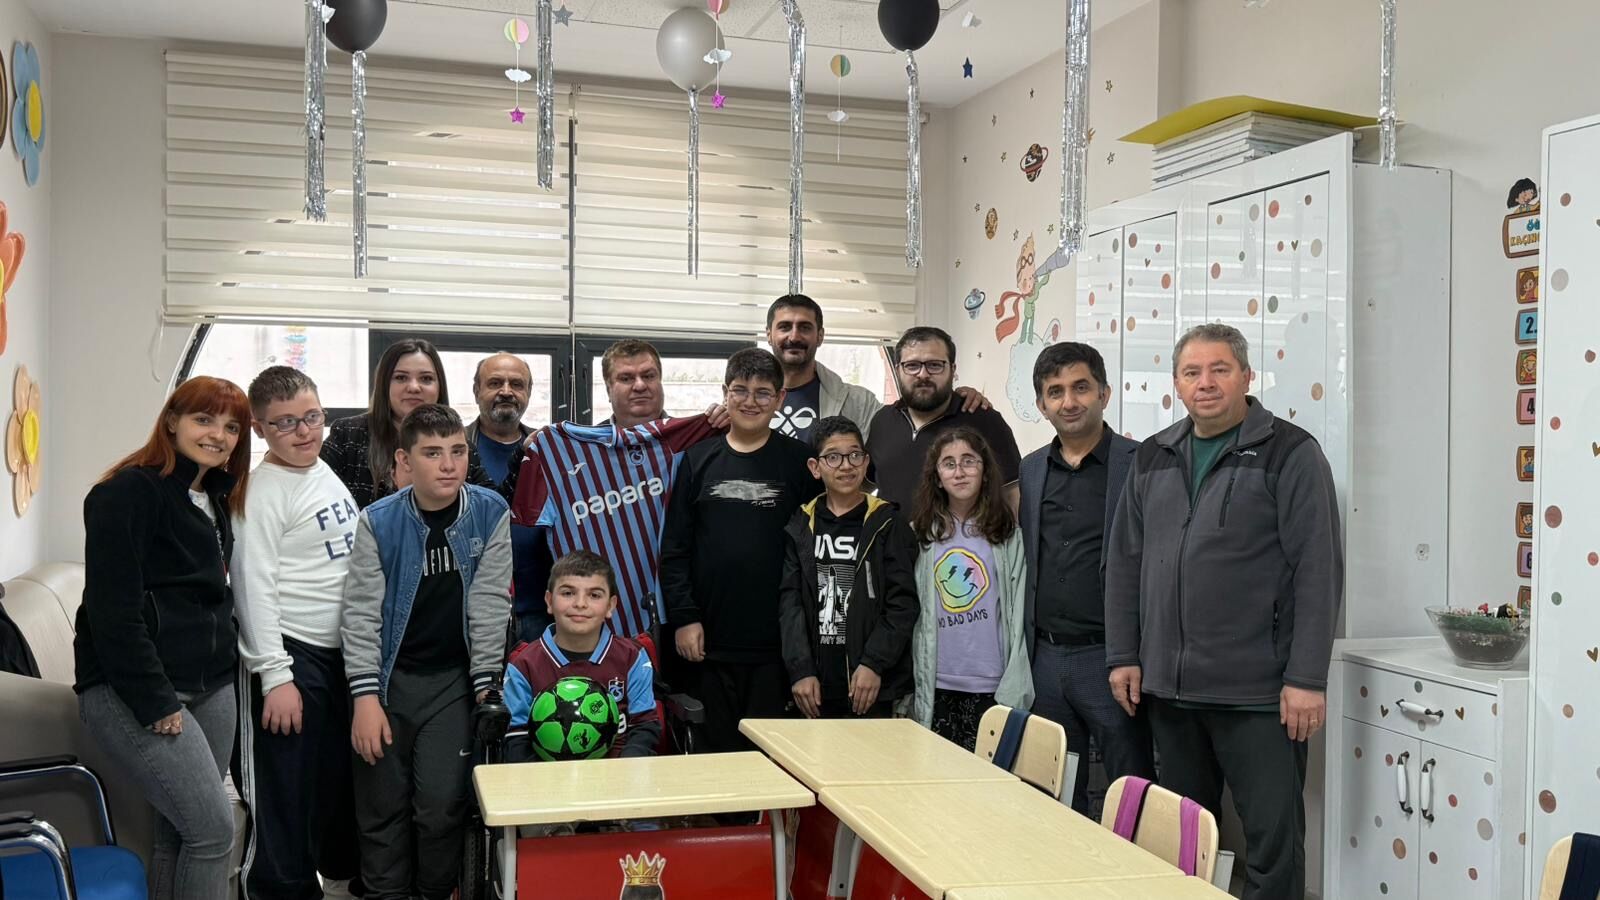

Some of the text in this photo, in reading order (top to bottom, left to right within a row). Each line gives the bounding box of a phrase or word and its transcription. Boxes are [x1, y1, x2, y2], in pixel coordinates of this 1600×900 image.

[571, 477, 664, 525] papara
[947, 614, 965, 627] BAD
[966, 609, 988, 623] DAYS
